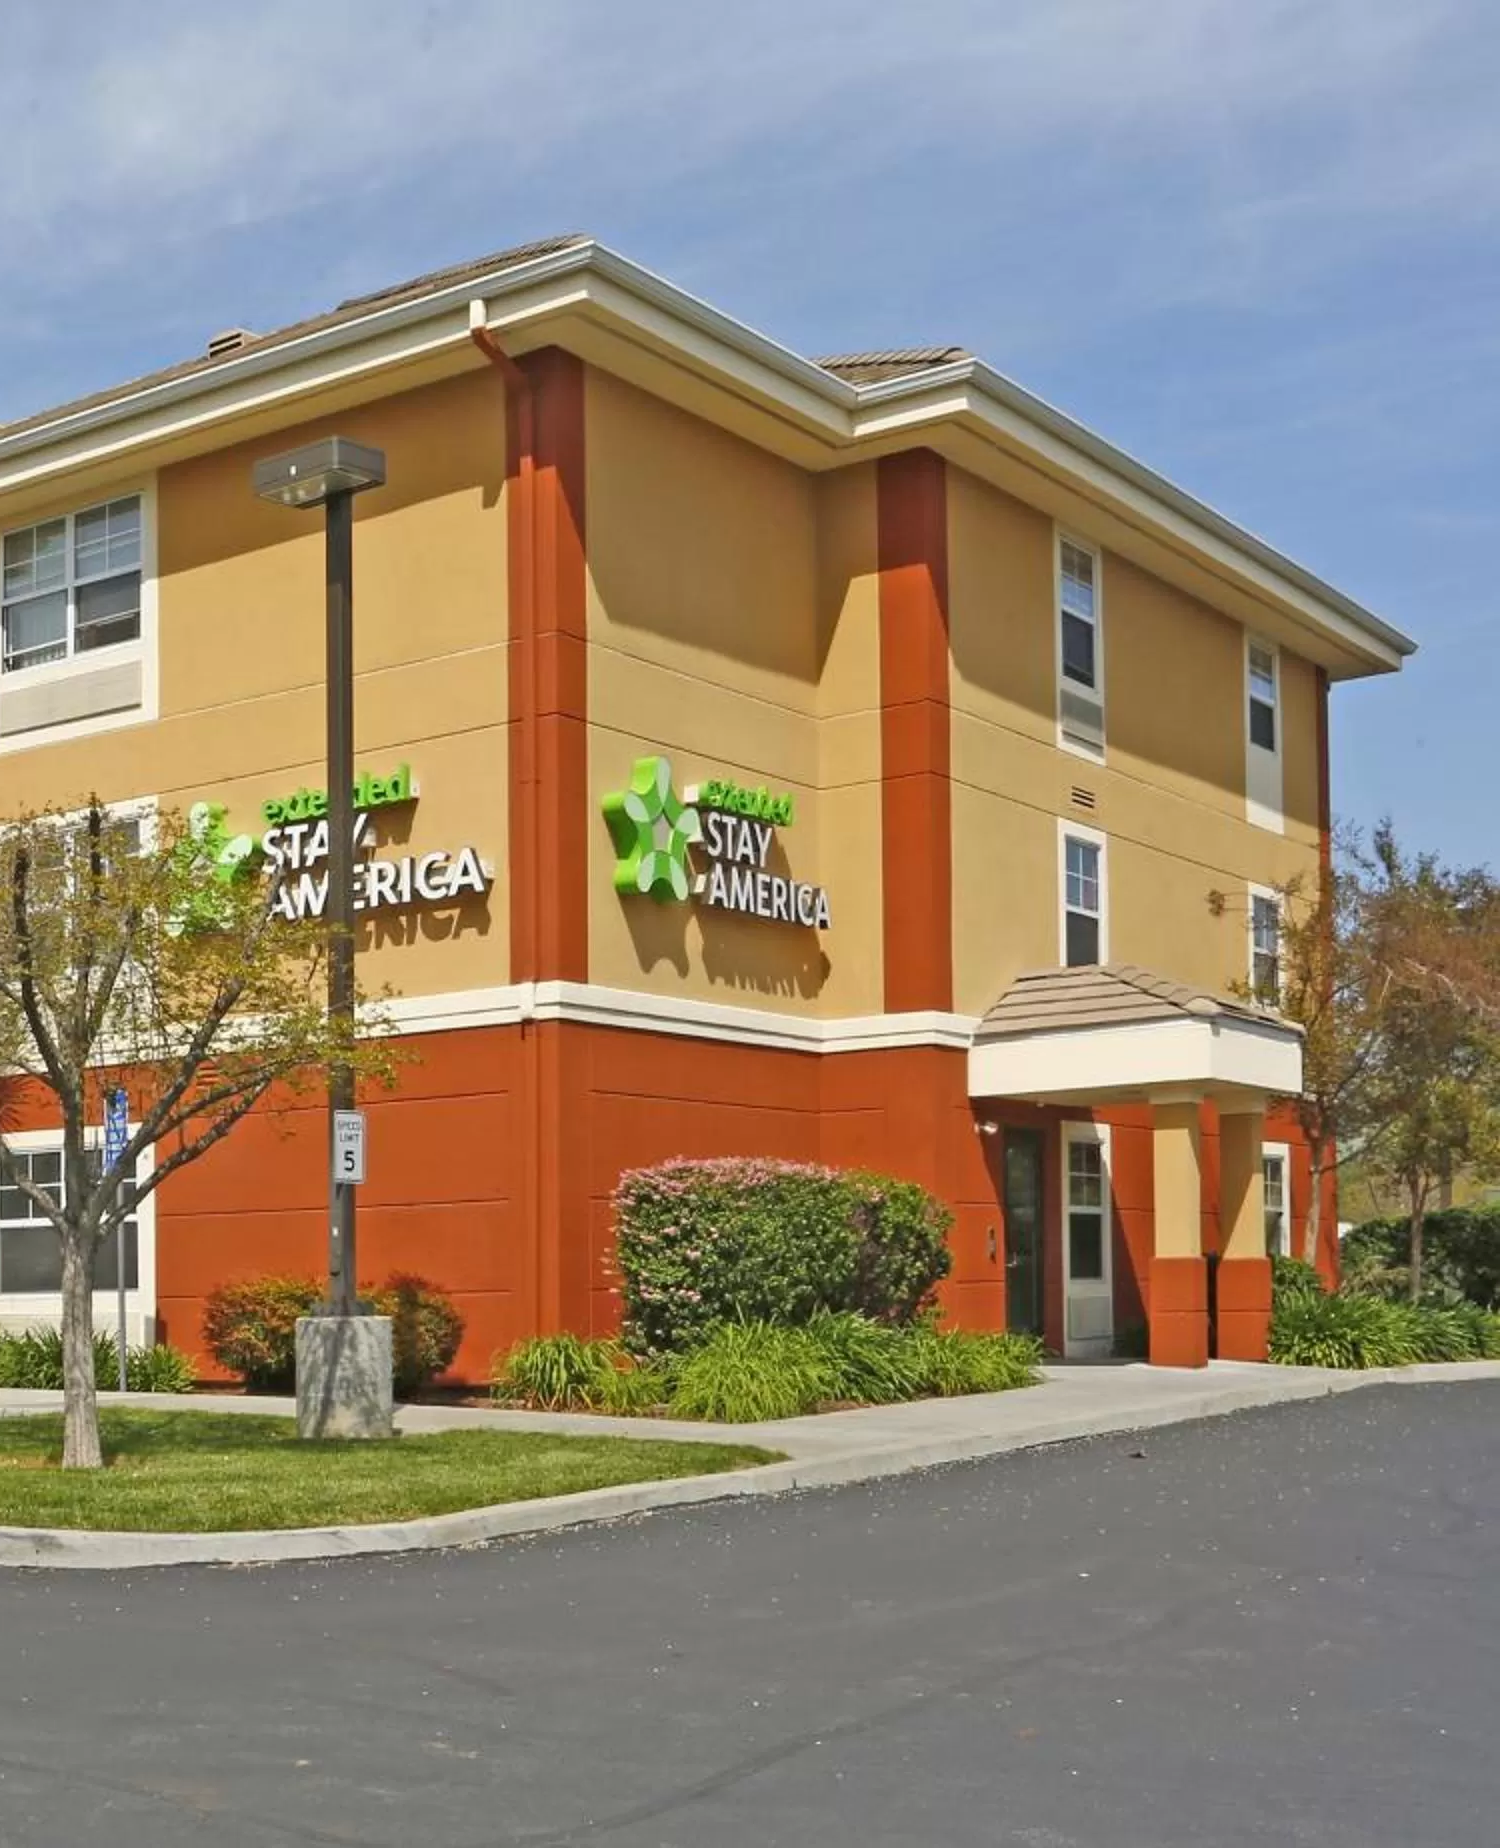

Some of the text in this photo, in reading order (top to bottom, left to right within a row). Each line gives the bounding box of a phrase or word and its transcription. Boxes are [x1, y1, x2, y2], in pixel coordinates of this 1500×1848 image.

[262, 763, 411, 824] exteded
[707, 812, 772, 867] STAY
[708, 863, 831, 928] AMERICA
[344, 1150, 355, 1172] 5
